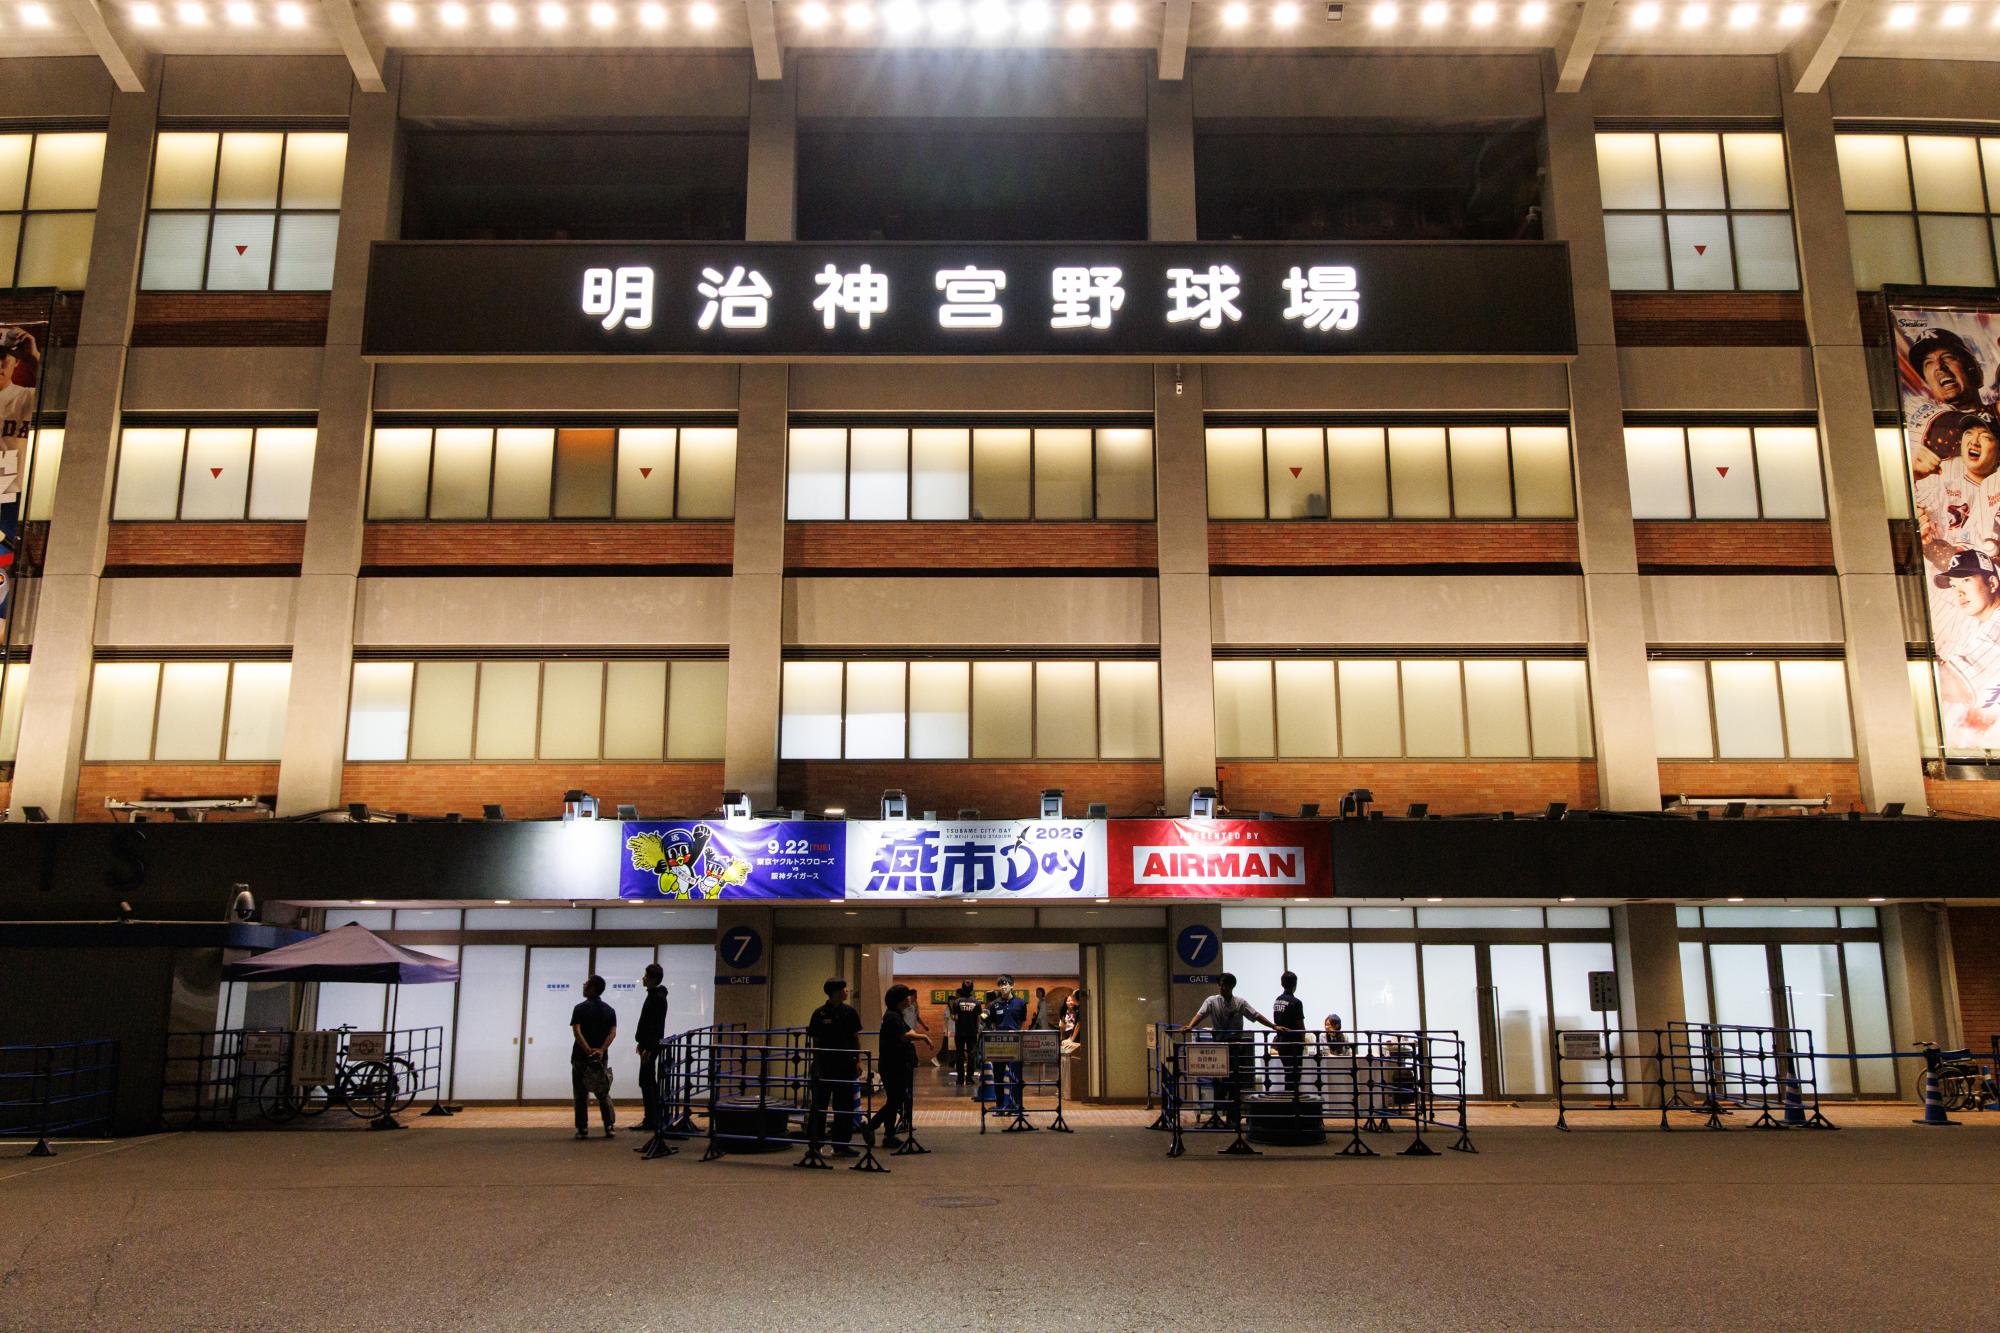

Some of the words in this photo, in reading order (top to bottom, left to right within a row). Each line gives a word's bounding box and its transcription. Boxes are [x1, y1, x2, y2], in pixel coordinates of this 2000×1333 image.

[581, 263, 1361, 332] 明治神宮野球場
[1036, 827, 1084, 840] 2026
[1180, 832, 1240, 840] PRESENTED
[1246, 832, 1260, 840] BY
[767, 839, 809, 855] 9.22
[756, 858, 835, 866] 東京ヤクルトスワローズ
[1142, 853, 1297, 878] AIRMAN
[770, 872, 819, 880] 阪神タイガース
[733, 935, 753, 962] 7
[1189, 934, 1209, 961] 7
[730, 976, 750, 984] GATE
[1189, 975, 1209, 983] GATE
